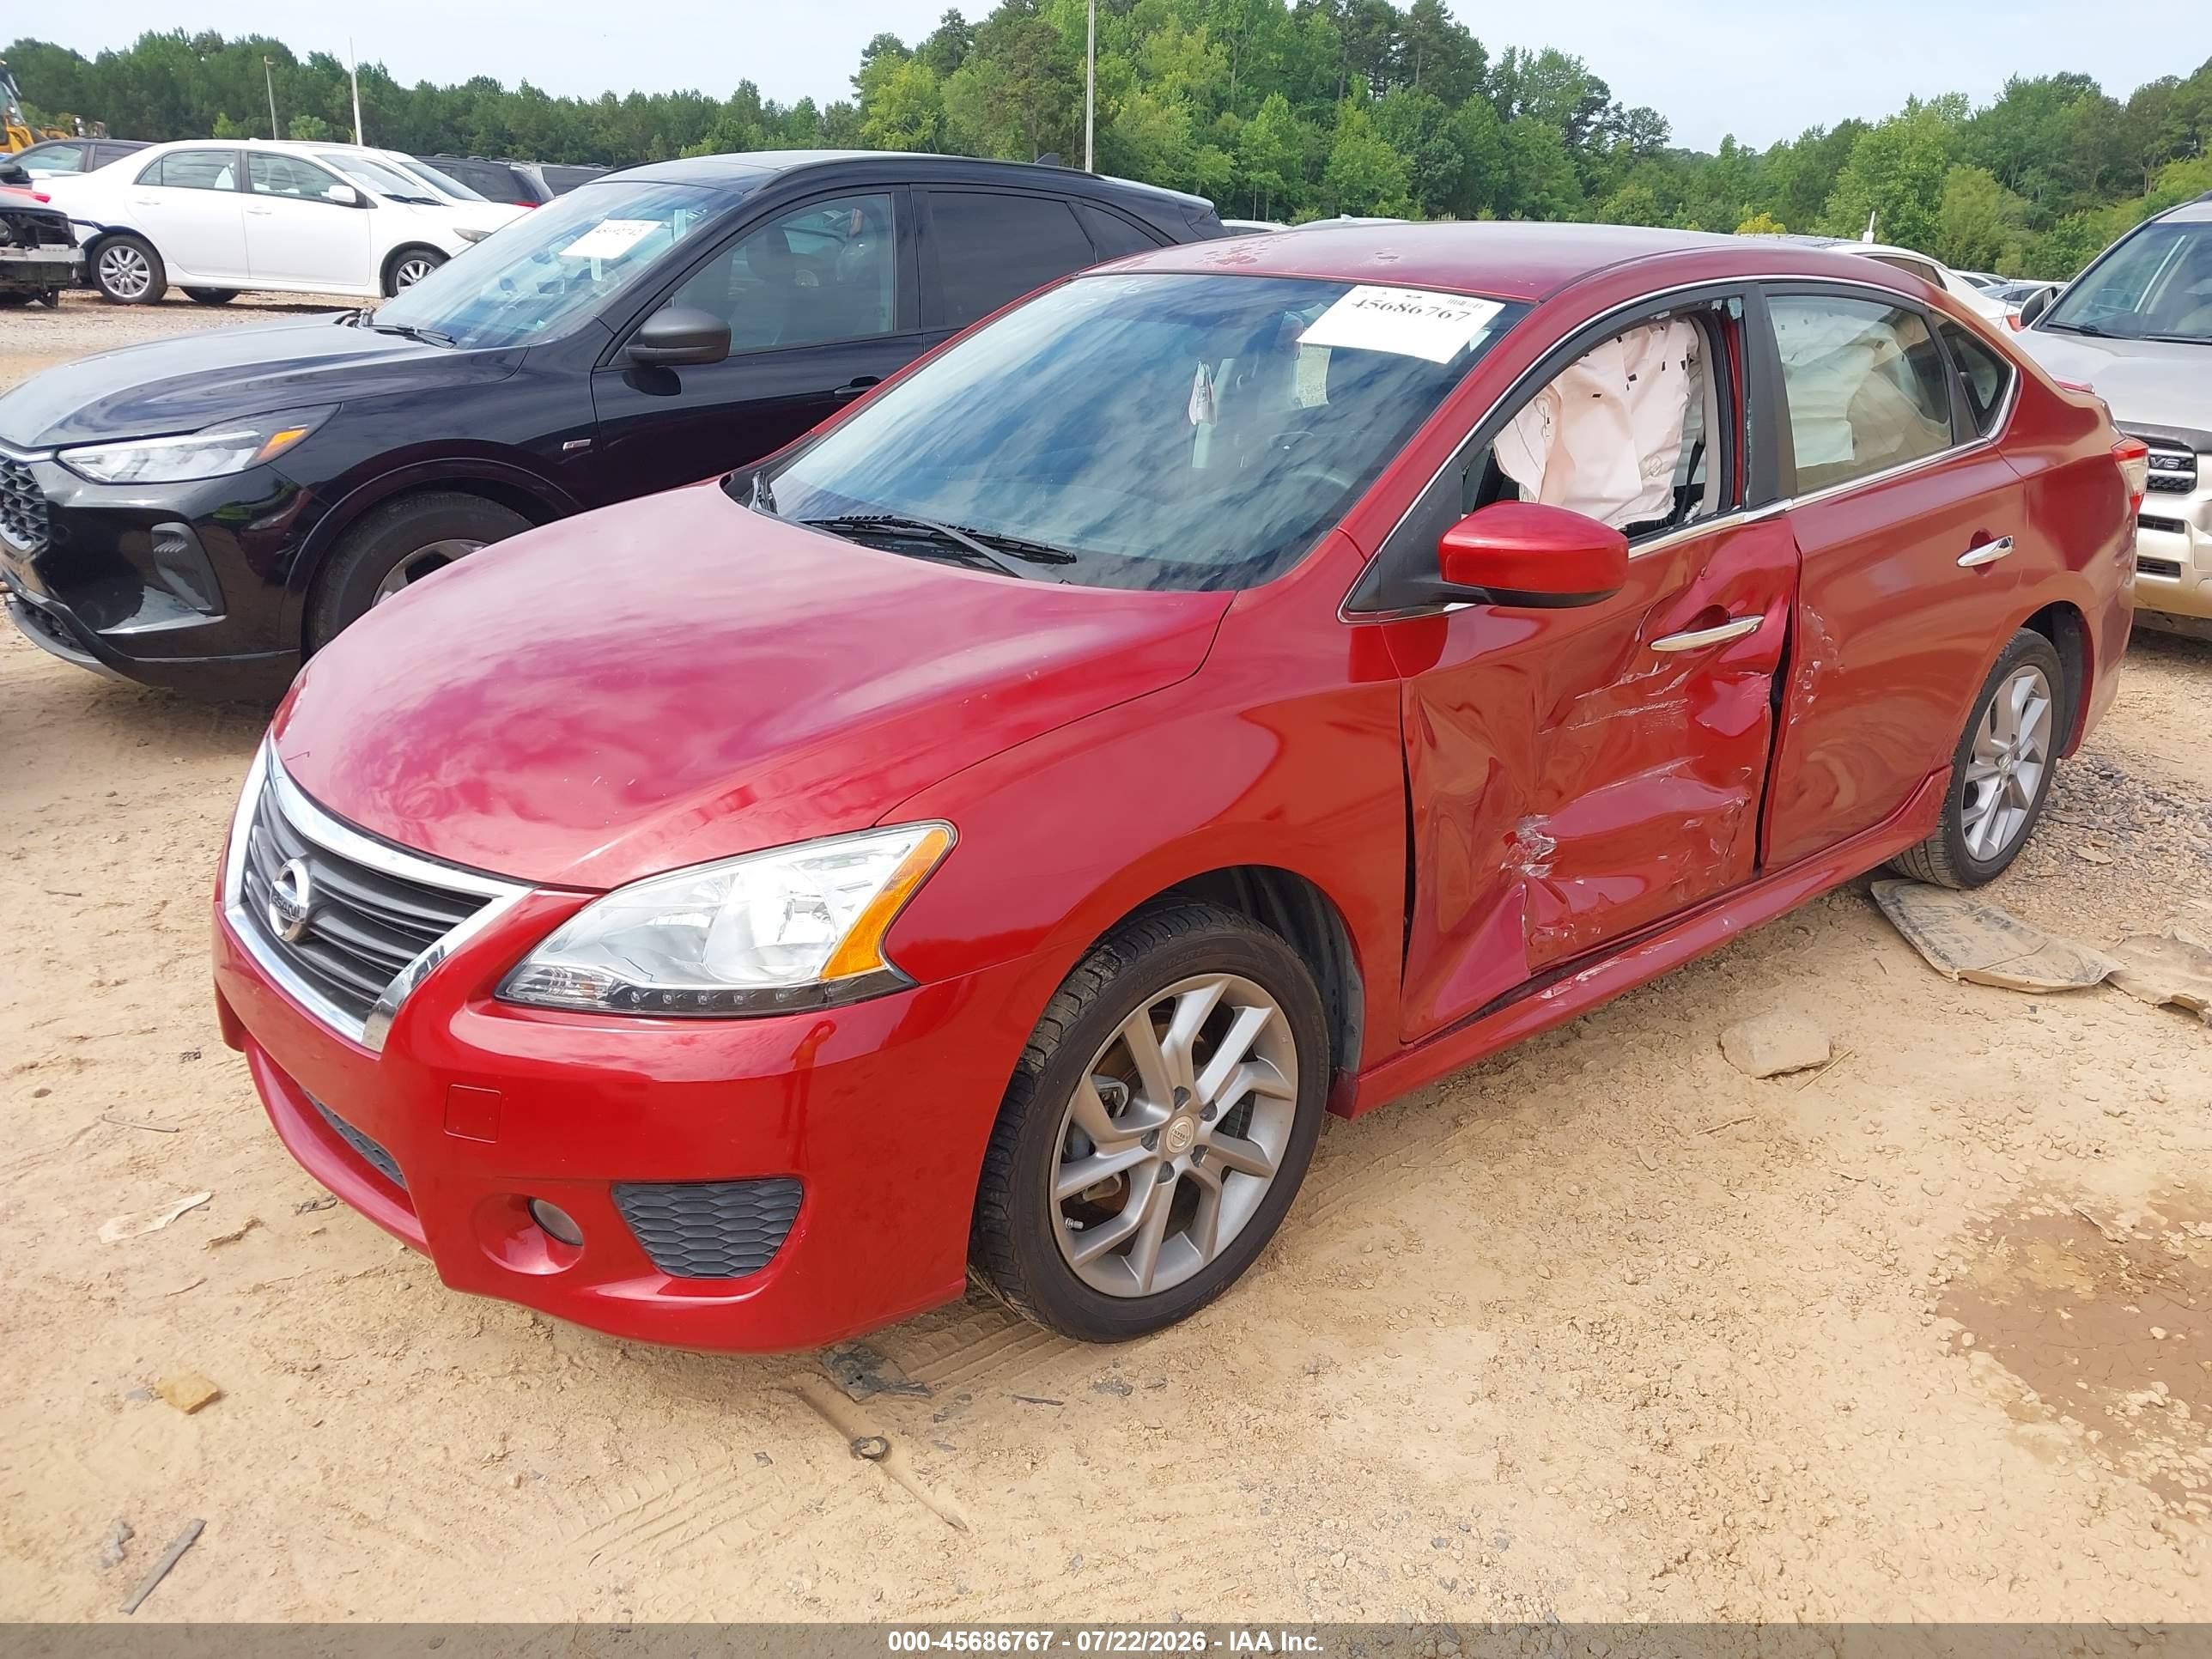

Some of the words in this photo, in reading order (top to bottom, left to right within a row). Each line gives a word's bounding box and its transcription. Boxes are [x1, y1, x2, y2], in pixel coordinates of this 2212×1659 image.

[1352, 298, 1472, 322] 45686767
[2150, 457, 2179, 470] V6
[271, 891, 301, 921] SSAN
